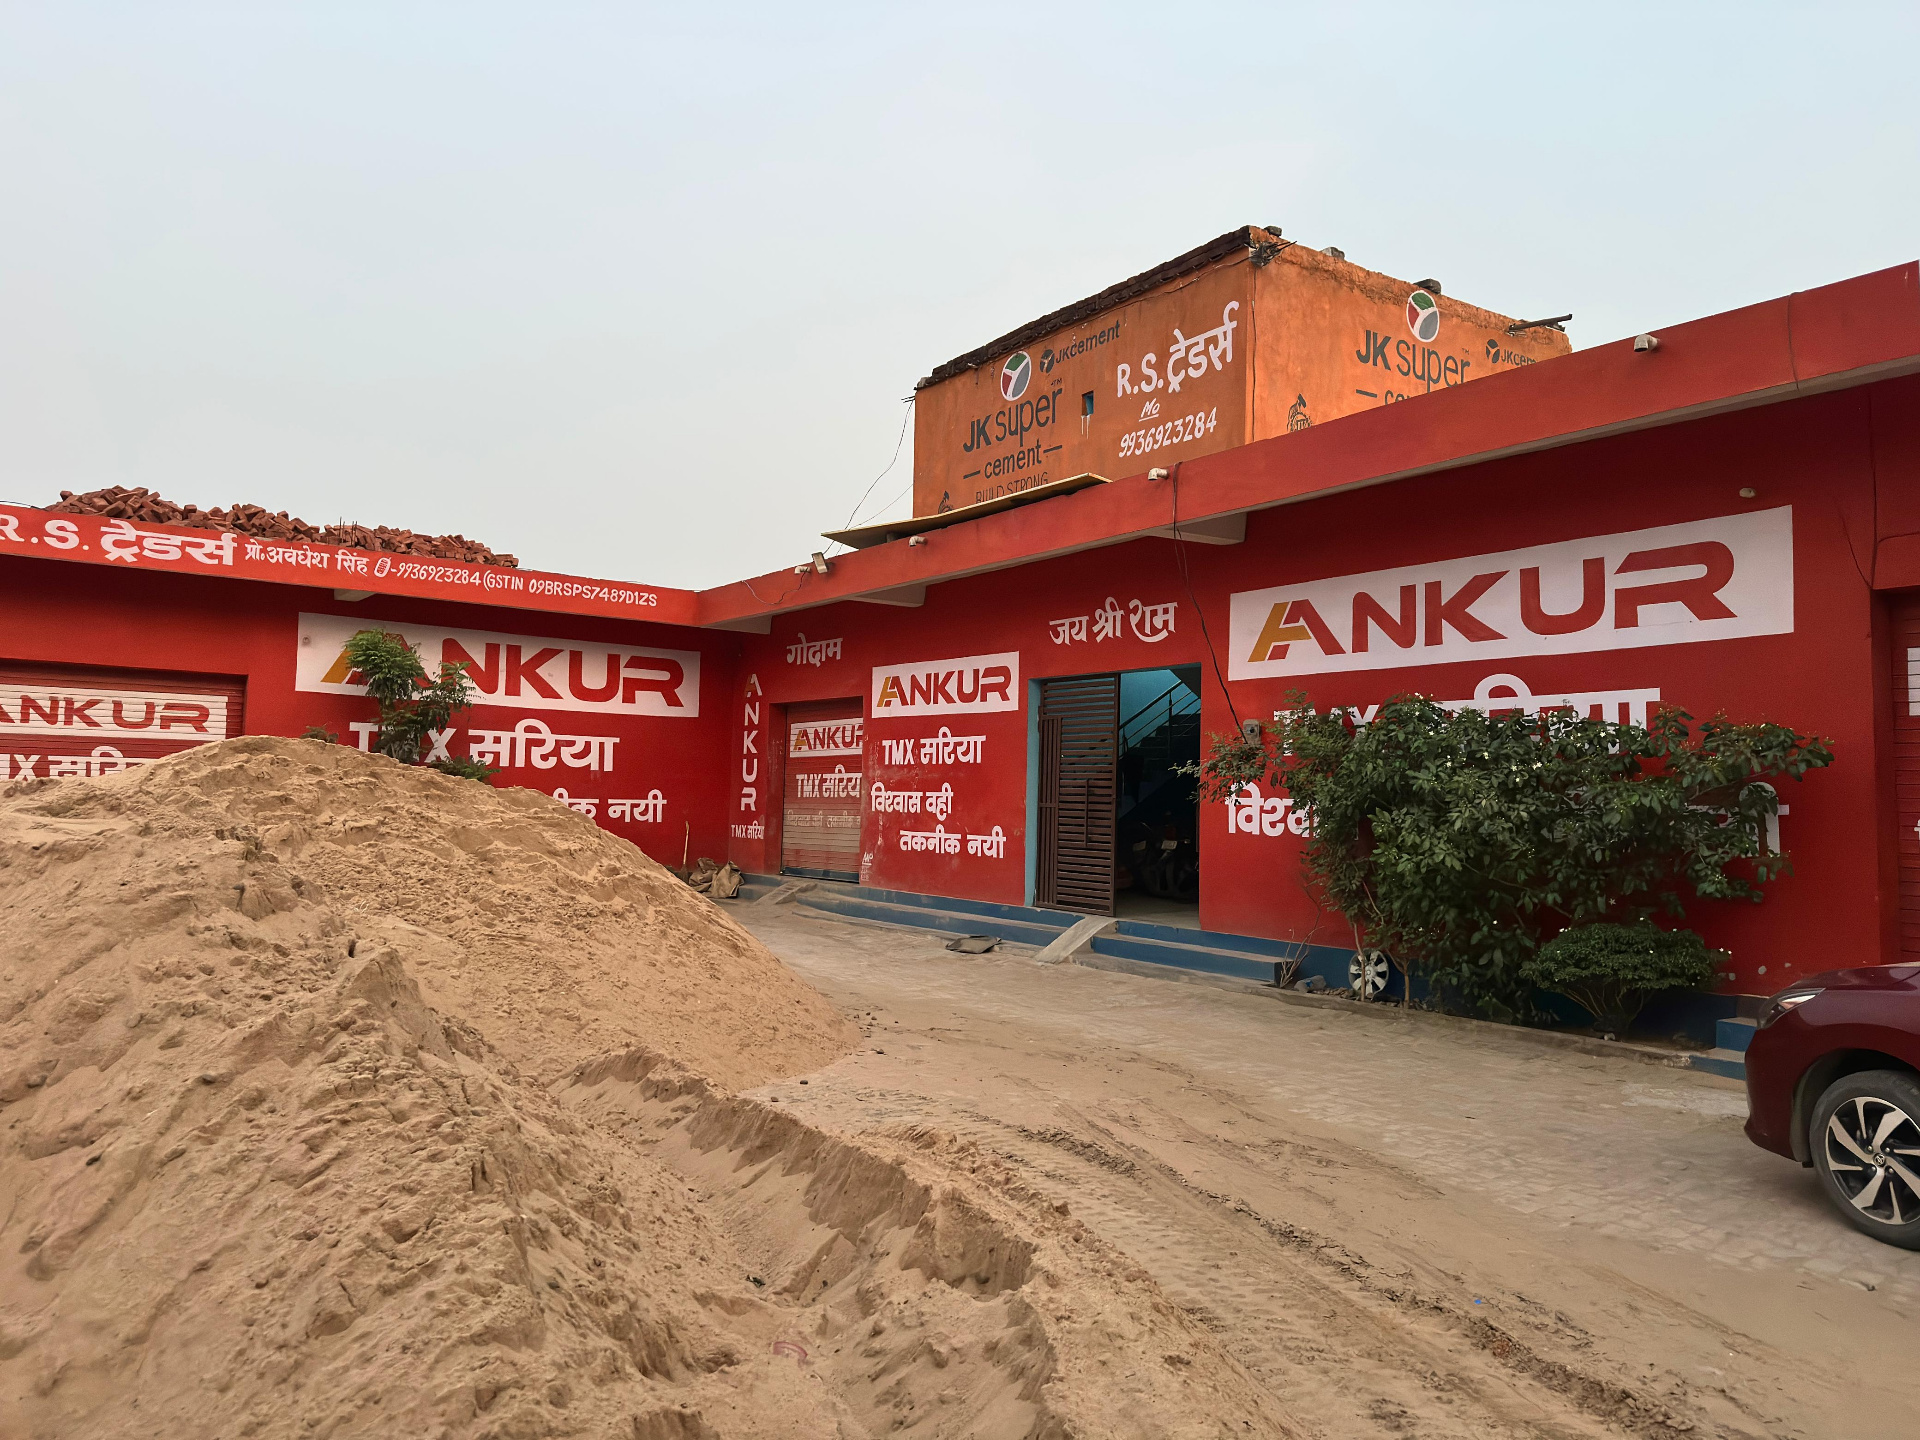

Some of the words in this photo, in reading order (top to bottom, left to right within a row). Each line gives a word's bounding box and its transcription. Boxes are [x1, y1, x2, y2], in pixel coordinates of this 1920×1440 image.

[1117, 353, 1163, 397] R.S.
[1167, 301, 1239, 393] ट्रेडर्स
[1119, 407, 1217, 457] 9936923284
[985, 439, 1042, 479] cement
[100, 519, 238, 566] ट्रेडर्स
[1049, 616, 1089, 646] जय
[1092, 597, 1125, 643] श्री
[1129, 599, 1178, 642] राम
[1248, 541, 1737, 662] ANKUR
[787, 632, 843, 668] गोदाम
[877, 666, 1012, 707] ANKUR
[0, 695, 210, 732] NKUR
[349, 722, 457, 763] TX
[469, 718, 620, 771] सरिया
[740, 673, 763, 811] ANKUR
[882, 738, 914, 765] TMX
[920, 726, 986, 764] सरिया
[796, 773, 821, 797] TMX
[871, 782, 923, 812] विश्वास
[926, 782, 953, 821] वही
[608, 789, 667, 822] नयी
[731, 825, 746, 838] TMX
[900, 824, 961, 854] तकनीक
[967, 825, 1006, 858] नयी
